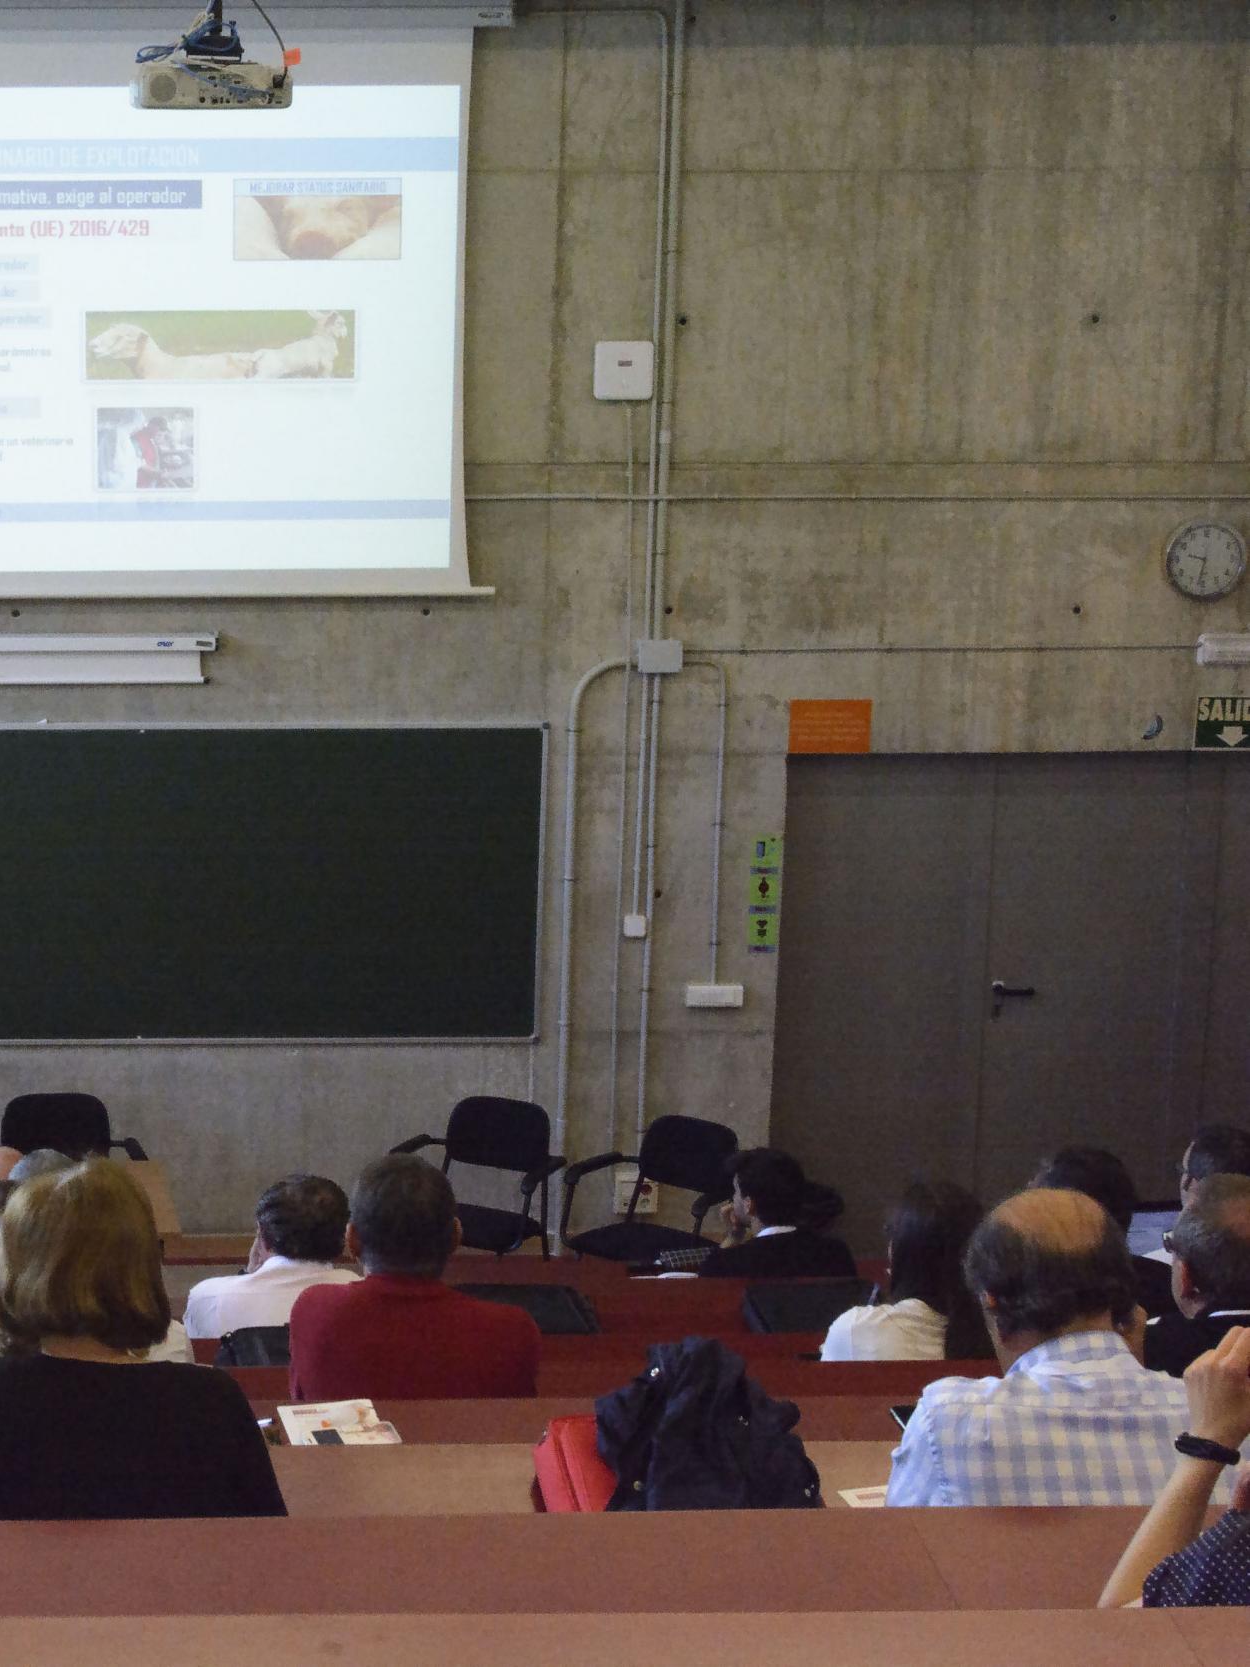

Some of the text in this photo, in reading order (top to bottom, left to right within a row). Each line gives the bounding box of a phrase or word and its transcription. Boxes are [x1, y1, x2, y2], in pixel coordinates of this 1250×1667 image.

[60, 146, 79, 168] DE
[56, 188, 94, 206] exige
[99, 187, 112, 204] al
[117, 186, 186, 206] operador
[30, 219, 65, 239] (UE)
[70, 219, 150, 238] 2016/429
